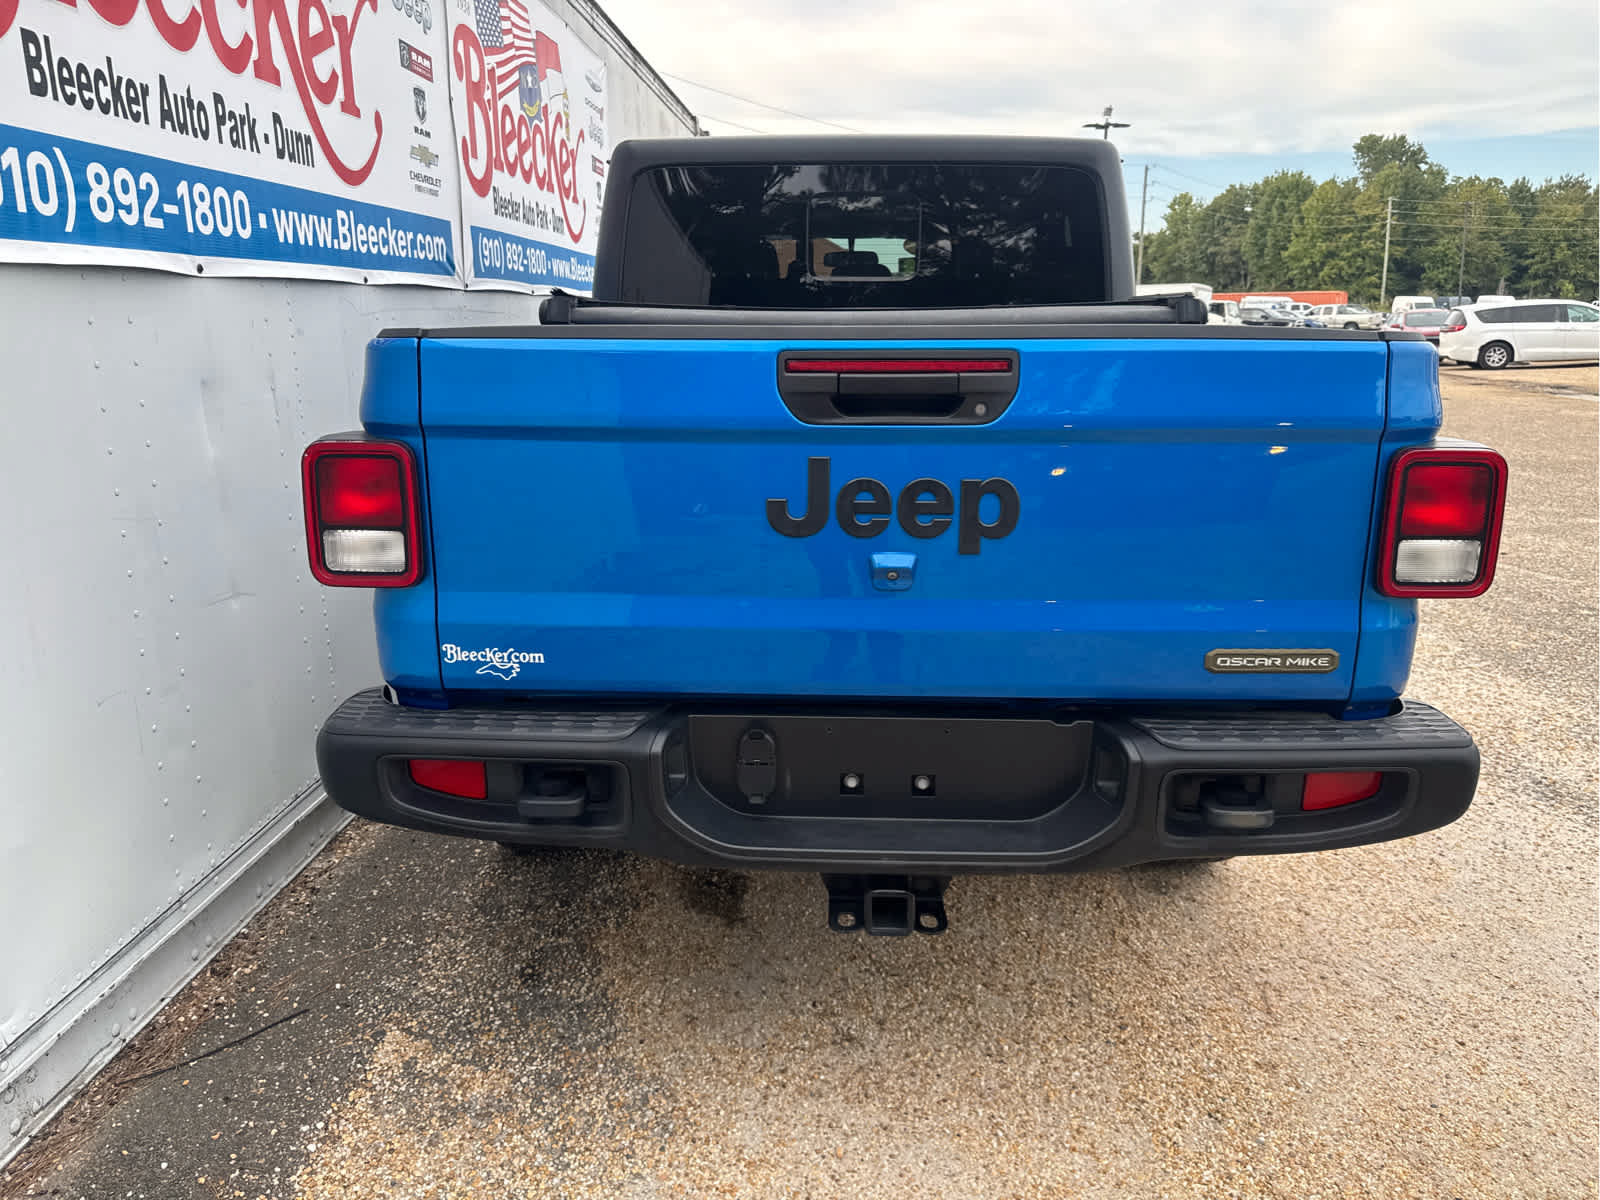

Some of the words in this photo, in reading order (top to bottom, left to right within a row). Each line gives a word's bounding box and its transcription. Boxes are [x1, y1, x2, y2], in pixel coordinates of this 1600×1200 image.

[411, 51, 431, 69] RAM
[0, 0, 383, 187] cker
[19, 26, 151, 126] Bleecker
[158, 73, 210, 142] Auto
[212, 91, 261, 154] Park
[271, 111, 315, 168] Dunn
[414, 126, 432, 139] RAM
[453, 24, 586, 244] Bleecker
[409, 170, 441, 188] CHEVROLET
[0, 146, 77, 233] 10)
[86, 162, 252, 240] 892-1800
[272, 207, 448, 263] www.Bleecker.com
[492, 185, 521, 223] Bleecker
[522, 195, 536, 228] Auto
[536, 201, 549, 231] Park
[552, 207, 565, 235] Dunn
[479, 232, 505, 275] (910)
[506, 242, 547, 275] 892-1800
[766, 456, 1021, 555] Jeep
[1216, 657, 1281, 666] OSCAR
[1285, 657, 1329, 666] MIKE
